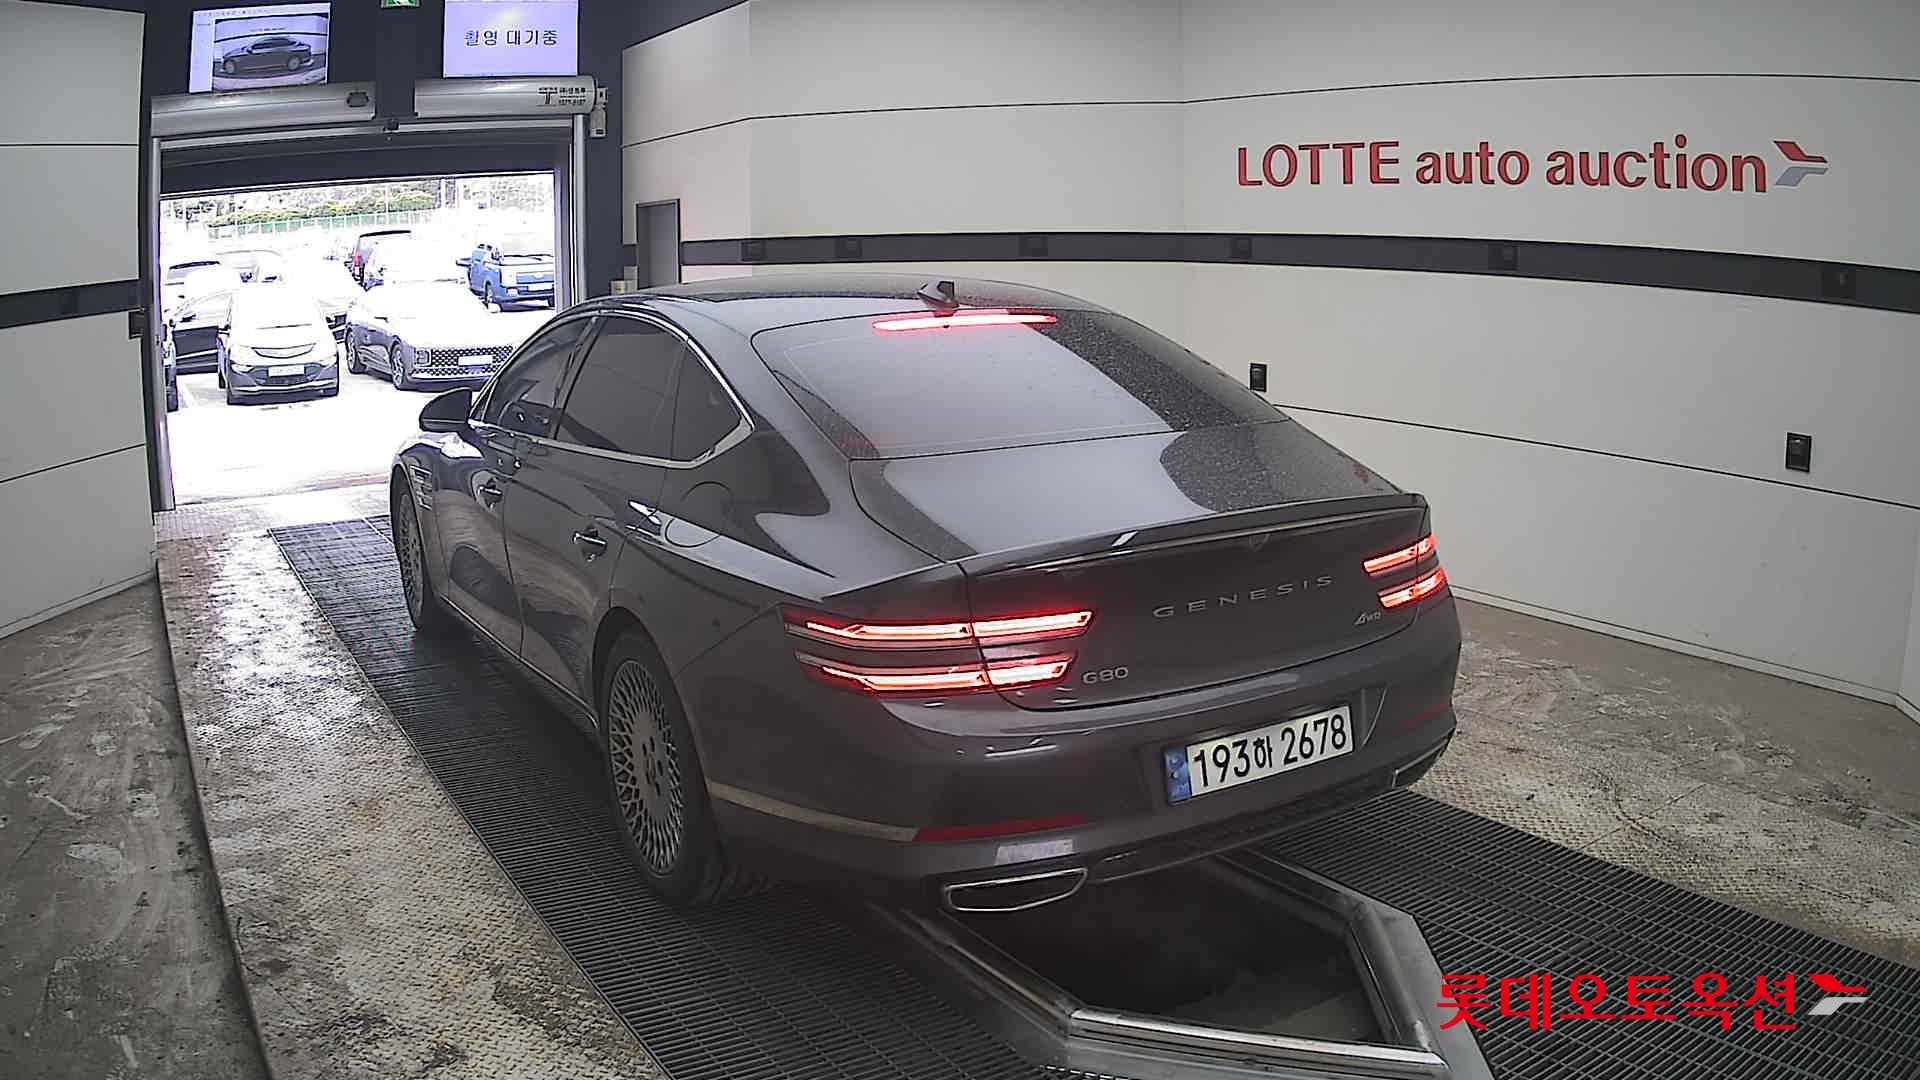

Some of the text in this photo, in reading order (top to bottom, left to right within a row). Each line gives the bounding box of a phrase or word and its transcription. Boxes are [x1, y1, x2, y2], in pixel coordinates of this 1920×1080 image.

[506, 30, 558, 46] 대기중
[1238, 135, 1767, 192] LOTTE auto auction
[1153, 575, 1333, 619] GENESIS
[1082, 666, 1130, 685] G80
[1193, 714, 1348, 788] 193하 2678
